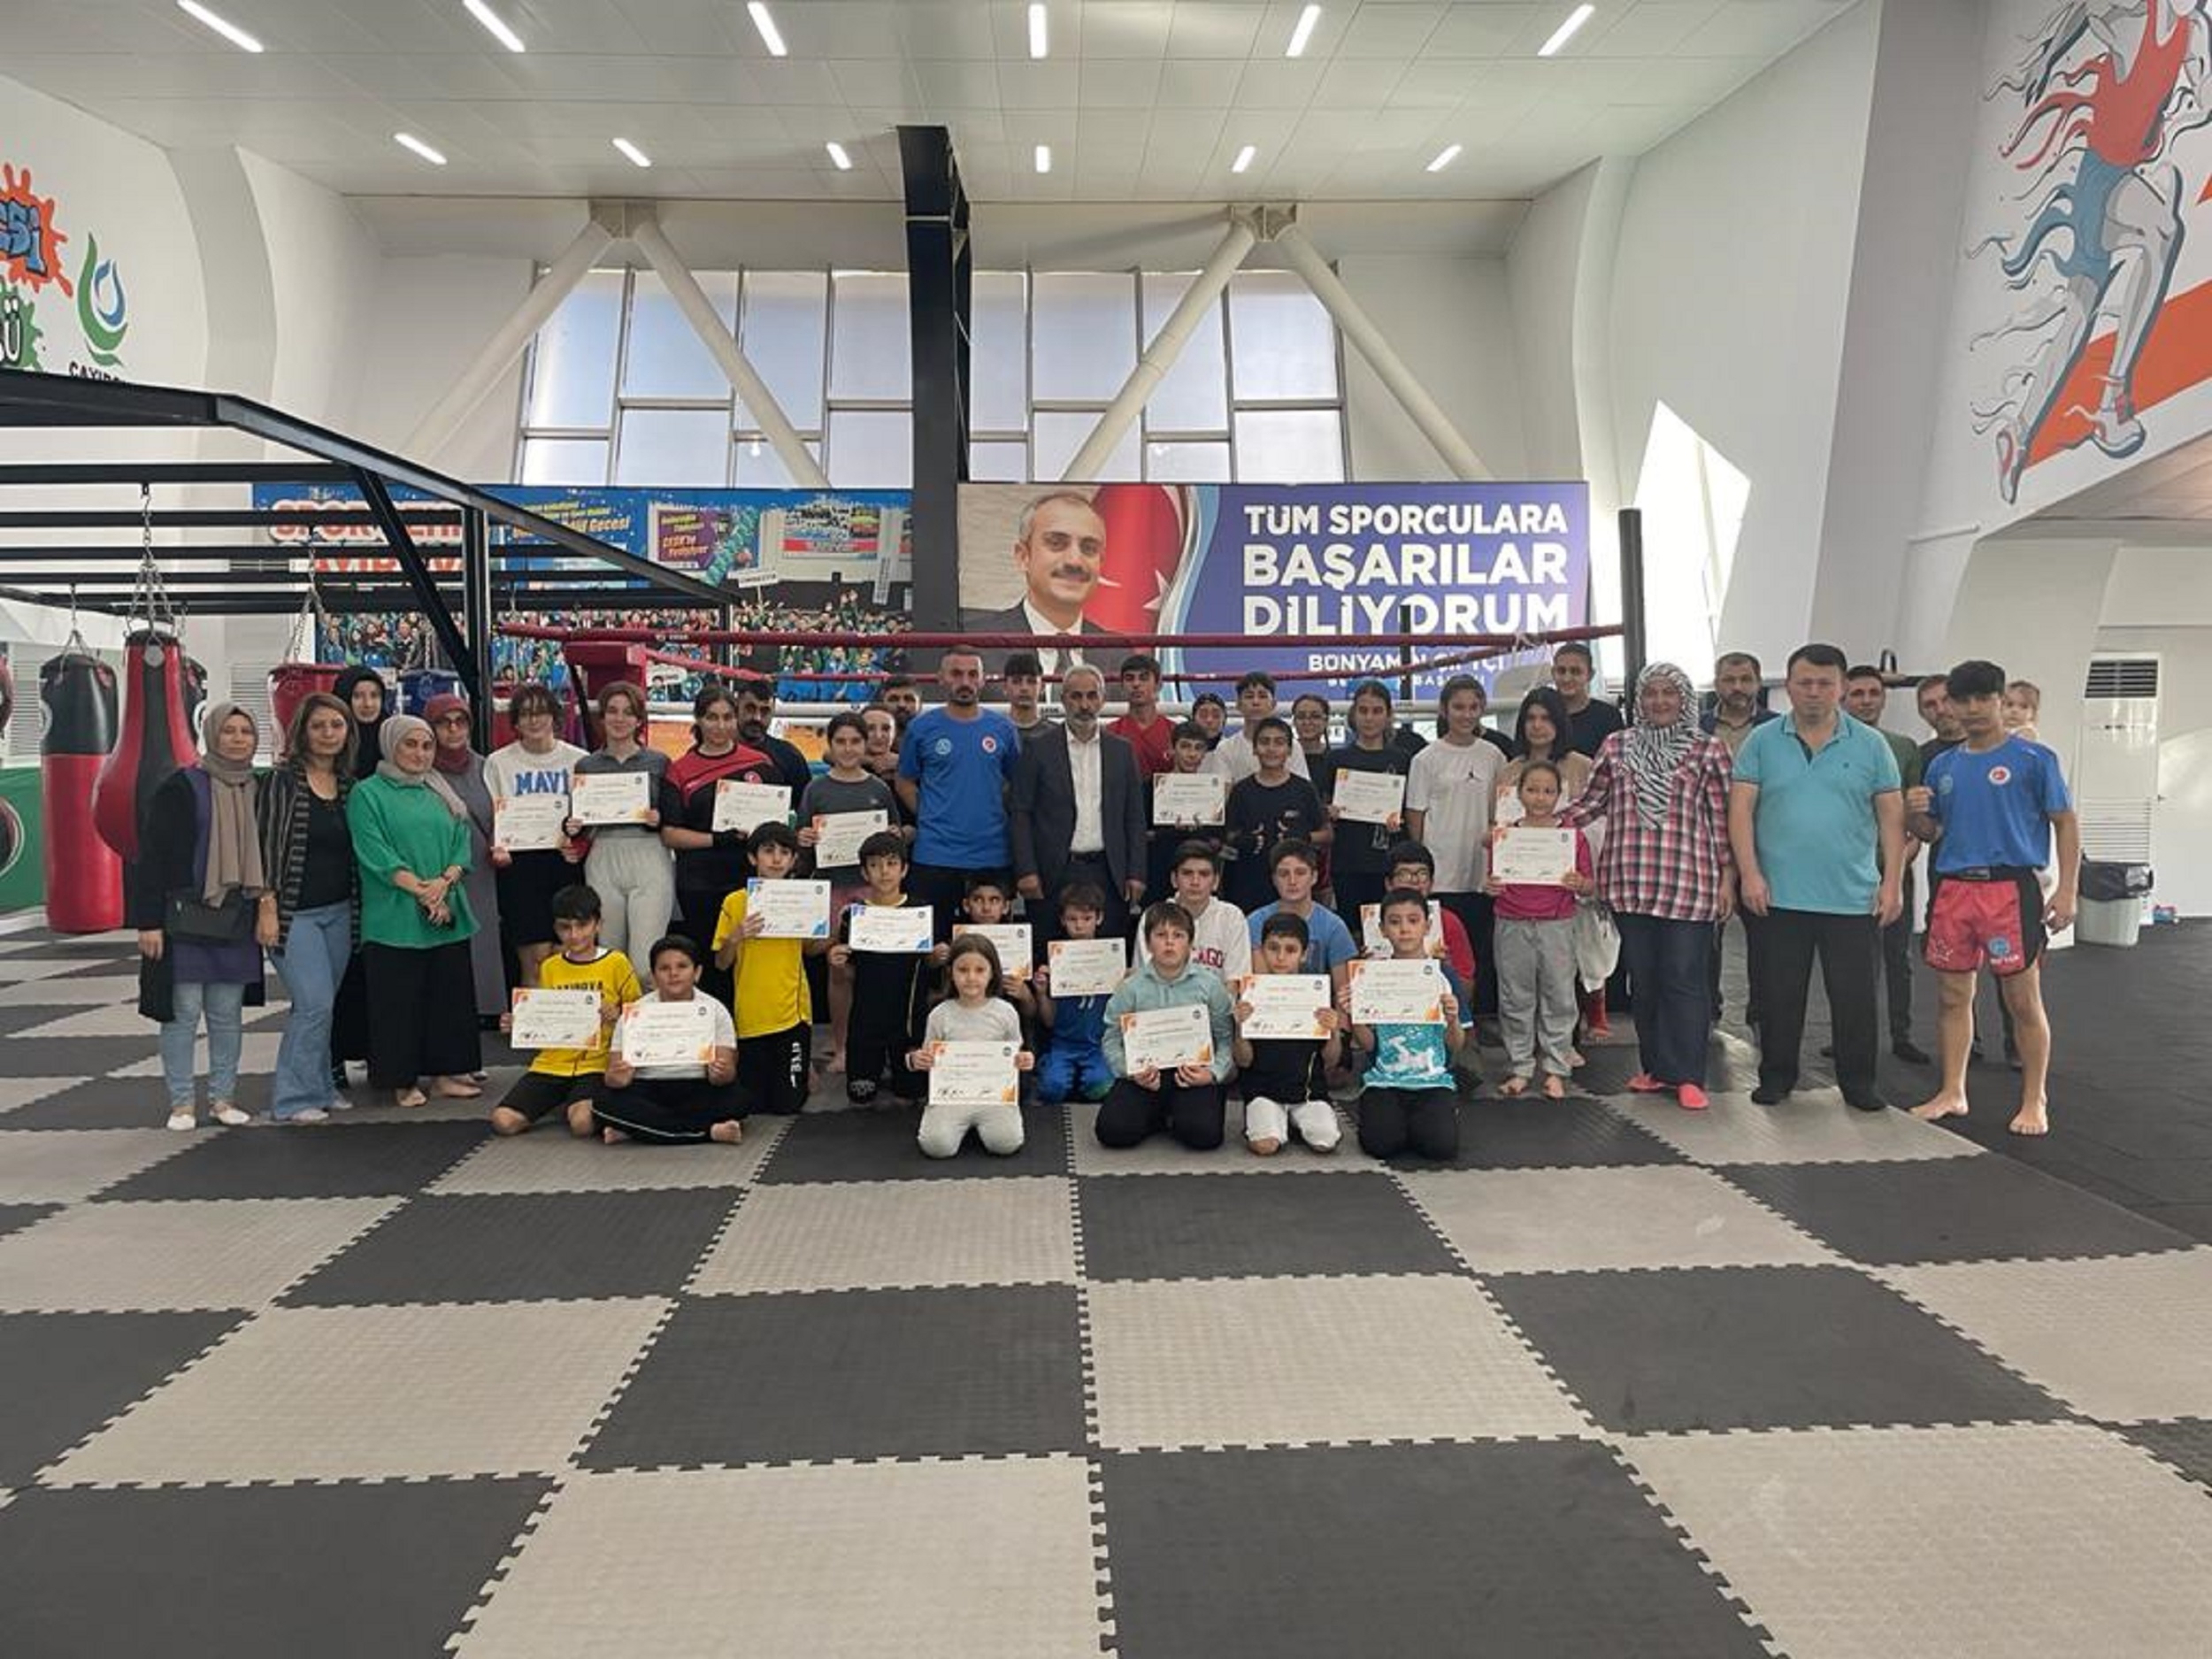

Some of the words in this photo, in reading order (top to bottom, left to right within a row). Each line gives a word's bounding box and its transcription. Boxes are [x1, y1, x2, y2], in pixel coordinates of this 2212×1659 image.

[1243, 505, 1319, 534] TÜM
[1328, 503, 1569, 534] SPORCULARA
[1243, 542, 1568, 591] BAŞARILAR
[1243, 594, 1570, 635] DİLİYORUM
